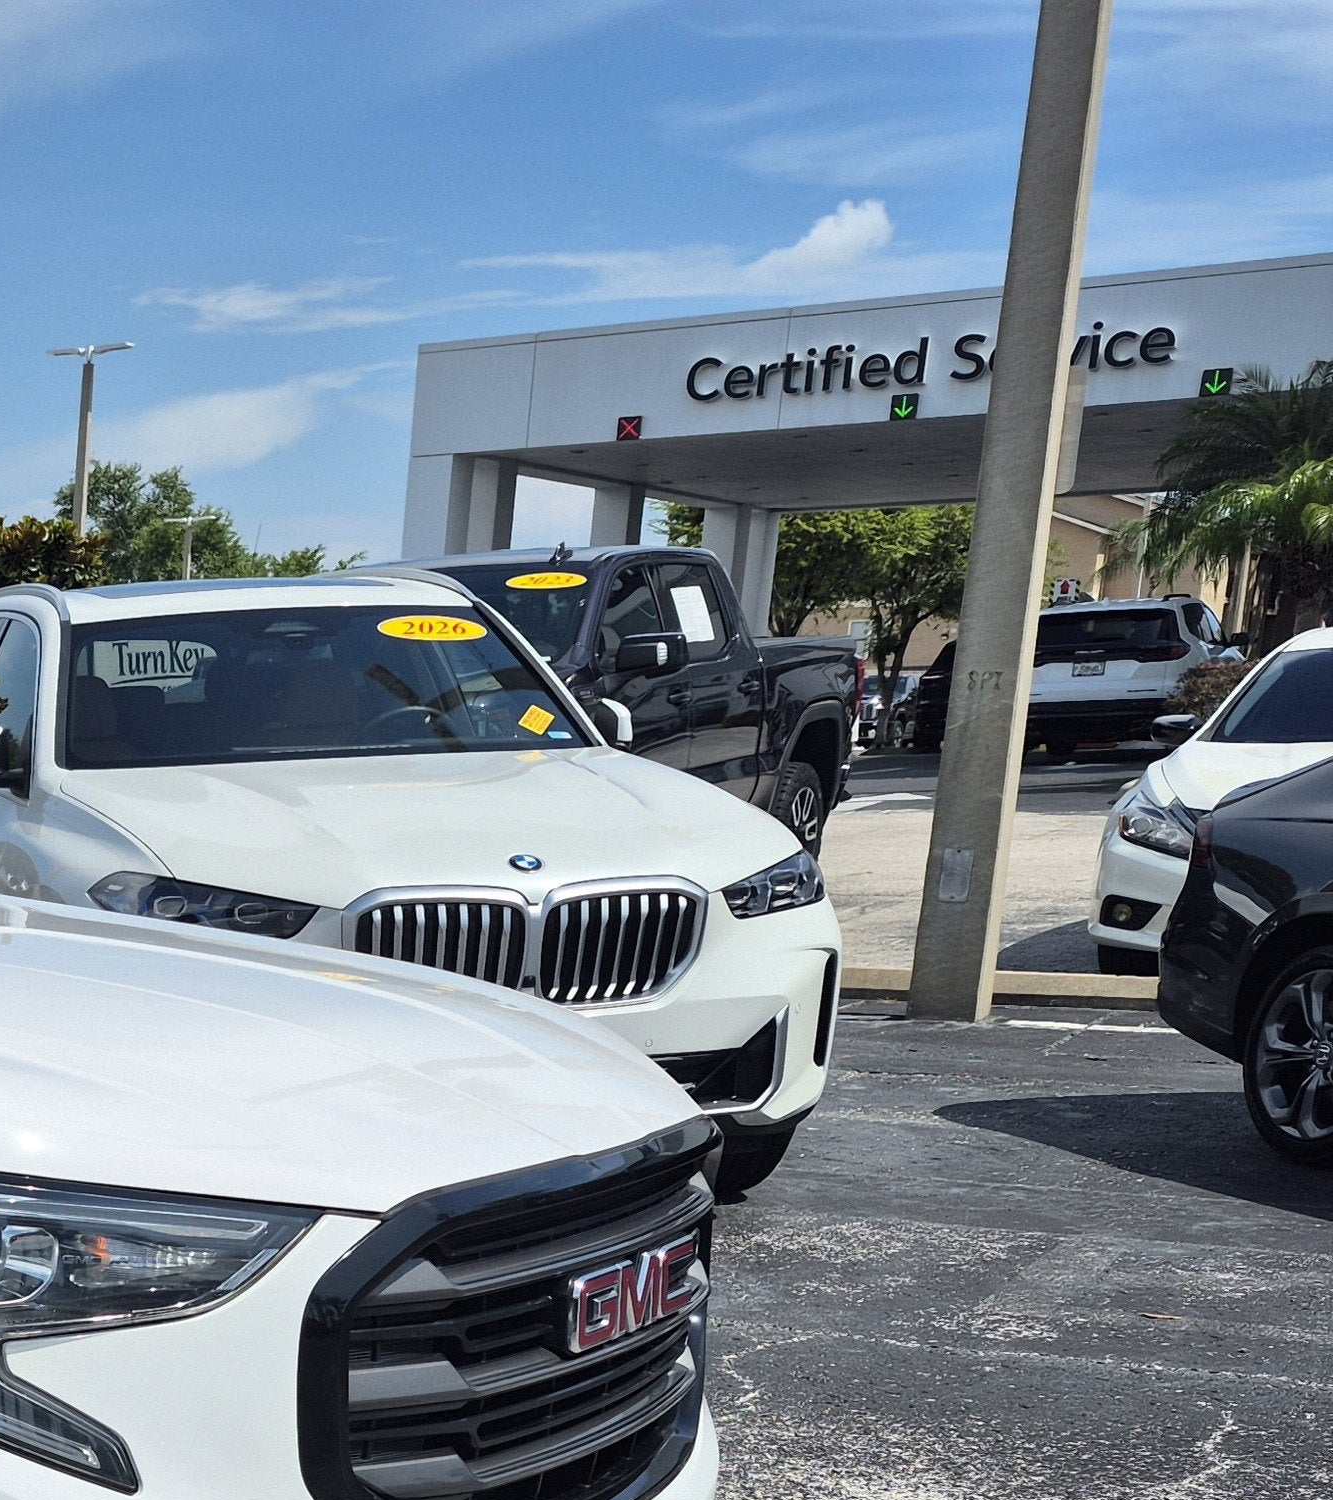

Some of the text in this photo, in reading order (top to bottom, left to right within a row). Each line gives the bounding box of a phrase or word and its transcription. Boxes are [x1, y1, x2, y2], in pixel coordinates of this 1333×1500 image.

[686, 321, 1177, 401] Certified Svice
[402, 620, 468, 636] 2026
[569, 1229, 699, 1353] GMC
